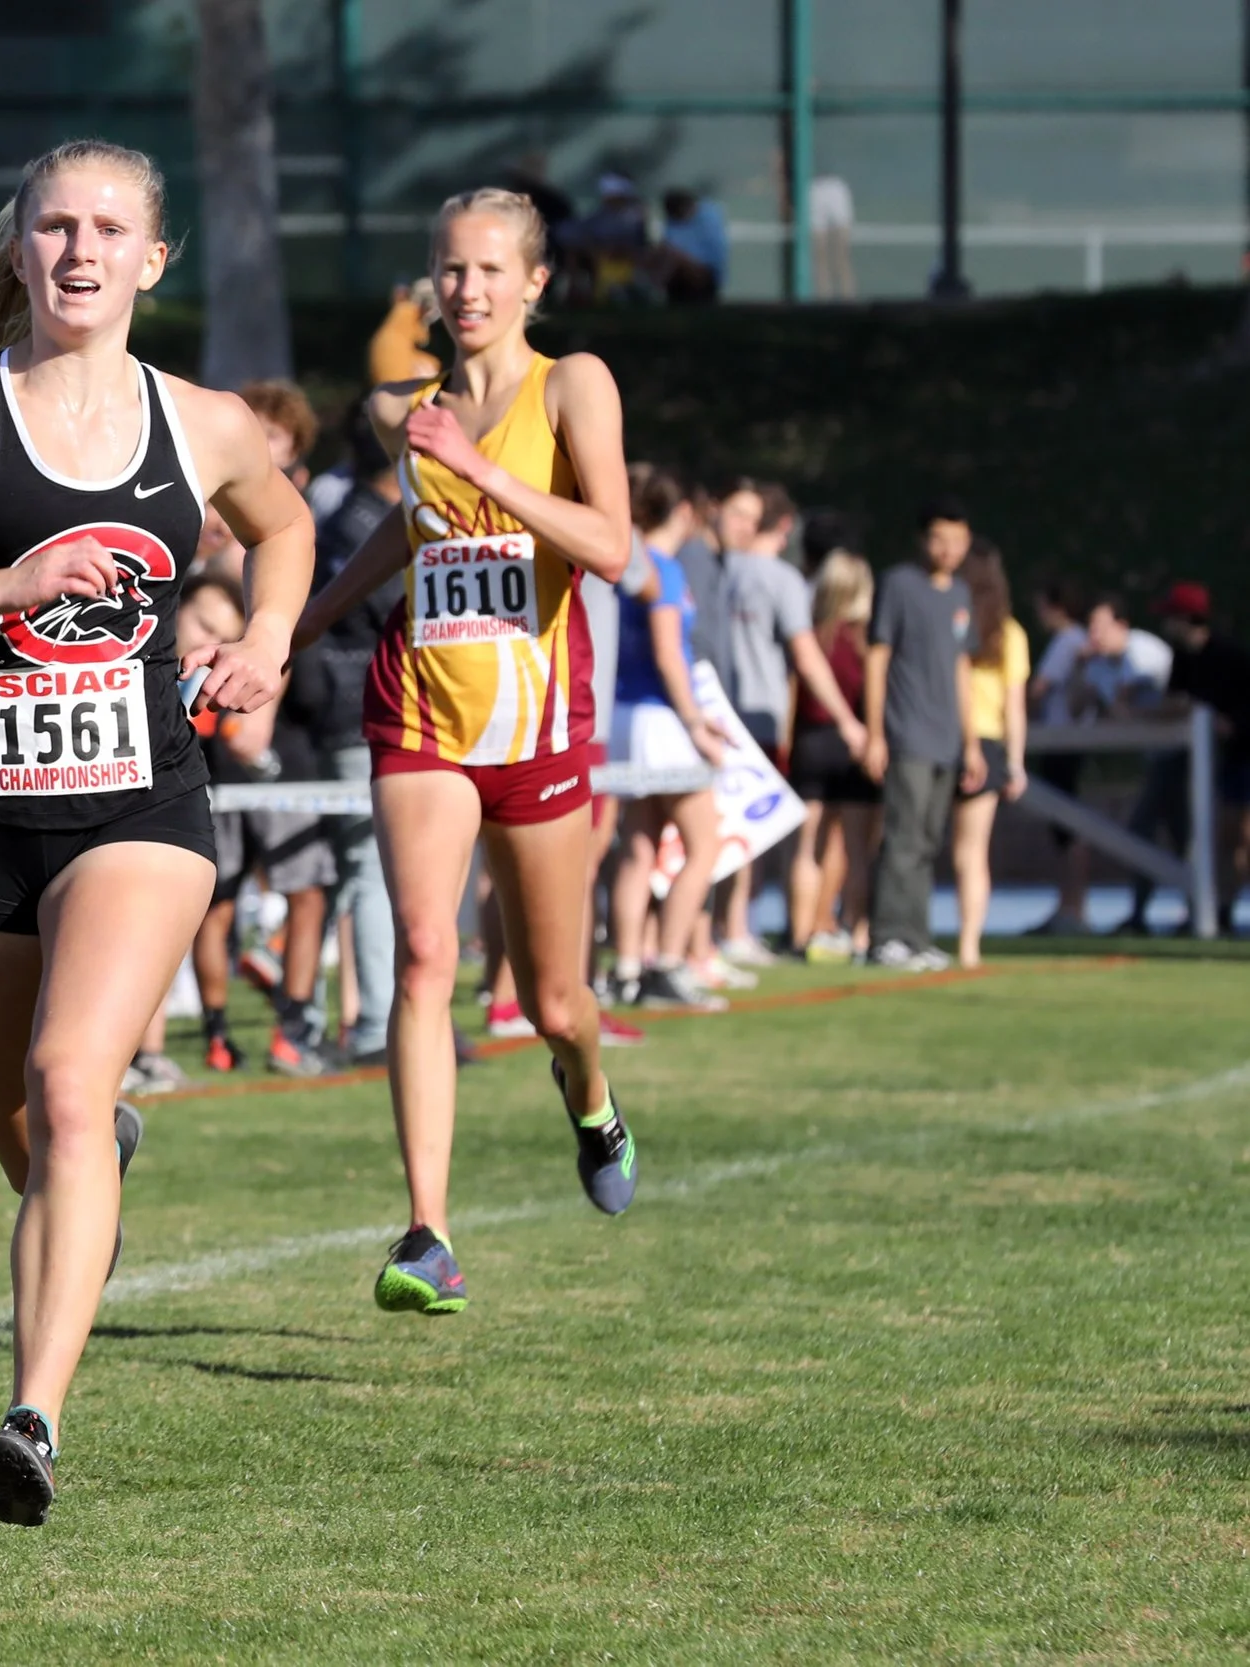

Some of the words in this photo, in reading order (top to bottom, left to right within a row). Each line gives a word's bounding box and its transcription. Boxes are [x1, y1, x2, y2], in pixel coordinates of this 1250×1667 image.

[413, 495, 527, 541] CM
[423, 541, 522, 566] SCIAC
[424, 565, 527, 619] 1610
[422, 616, 529, 640] CHAMPIONSHIPS
[0, 697, 136, 765] 1561
[0, 760, 139, 791] CHAMPIONSHIPS
